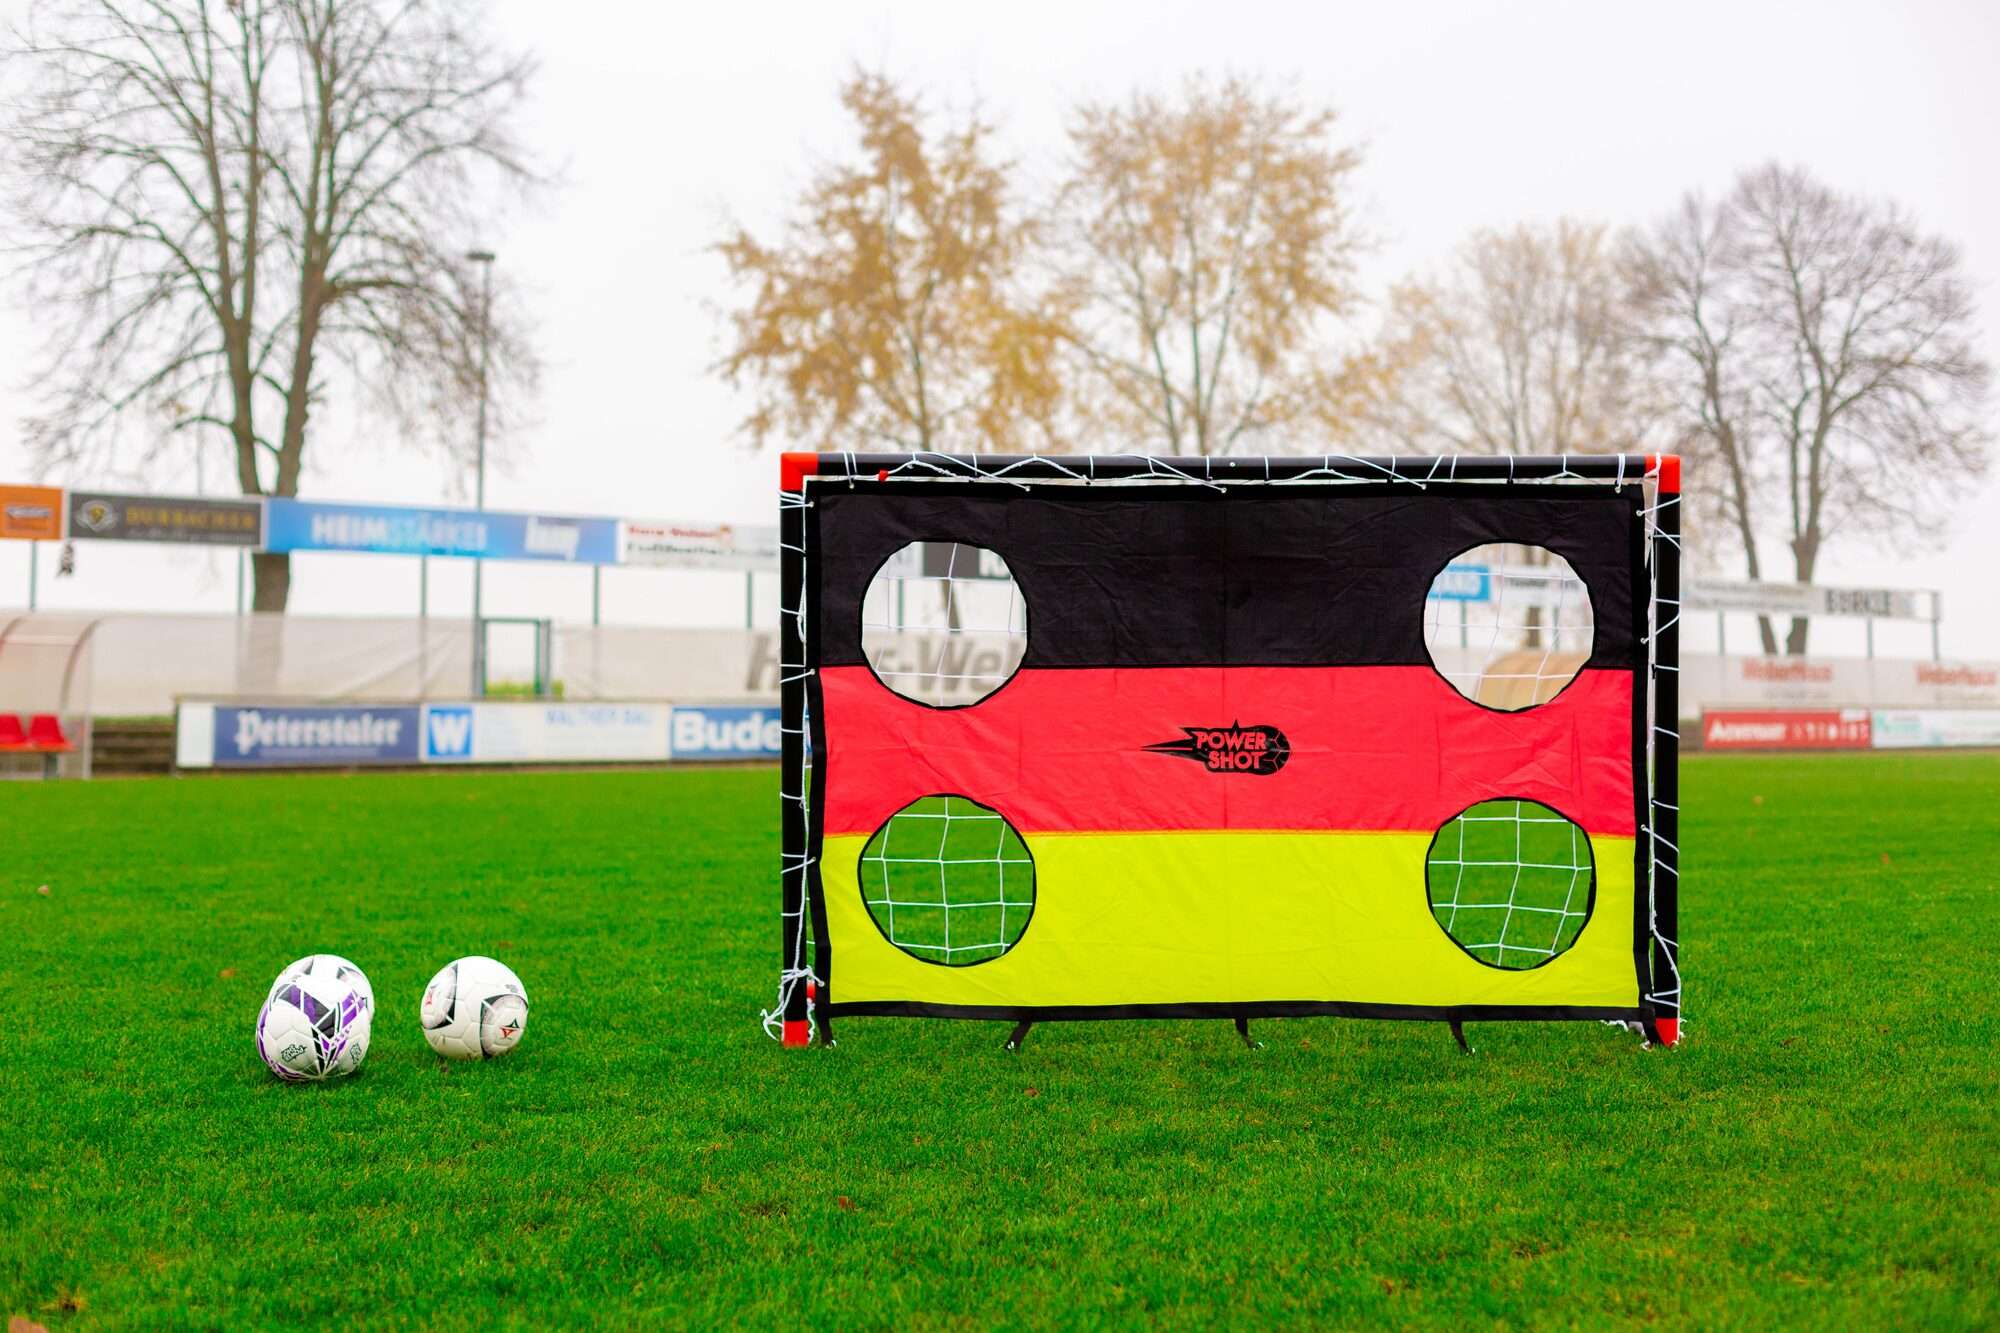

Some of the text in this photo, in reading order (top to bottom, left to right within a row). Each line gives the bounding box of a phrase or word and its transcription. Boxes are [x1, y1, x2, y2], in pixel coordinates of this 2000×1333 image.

[234, 710, 402, 755] Peterstaler
[429, 711, 471, 753] W
[673, 711, 781, 751] Bude
[1193, 731, 1267, 750] POWER
[1208, 751, 1267, 769] SHOT
